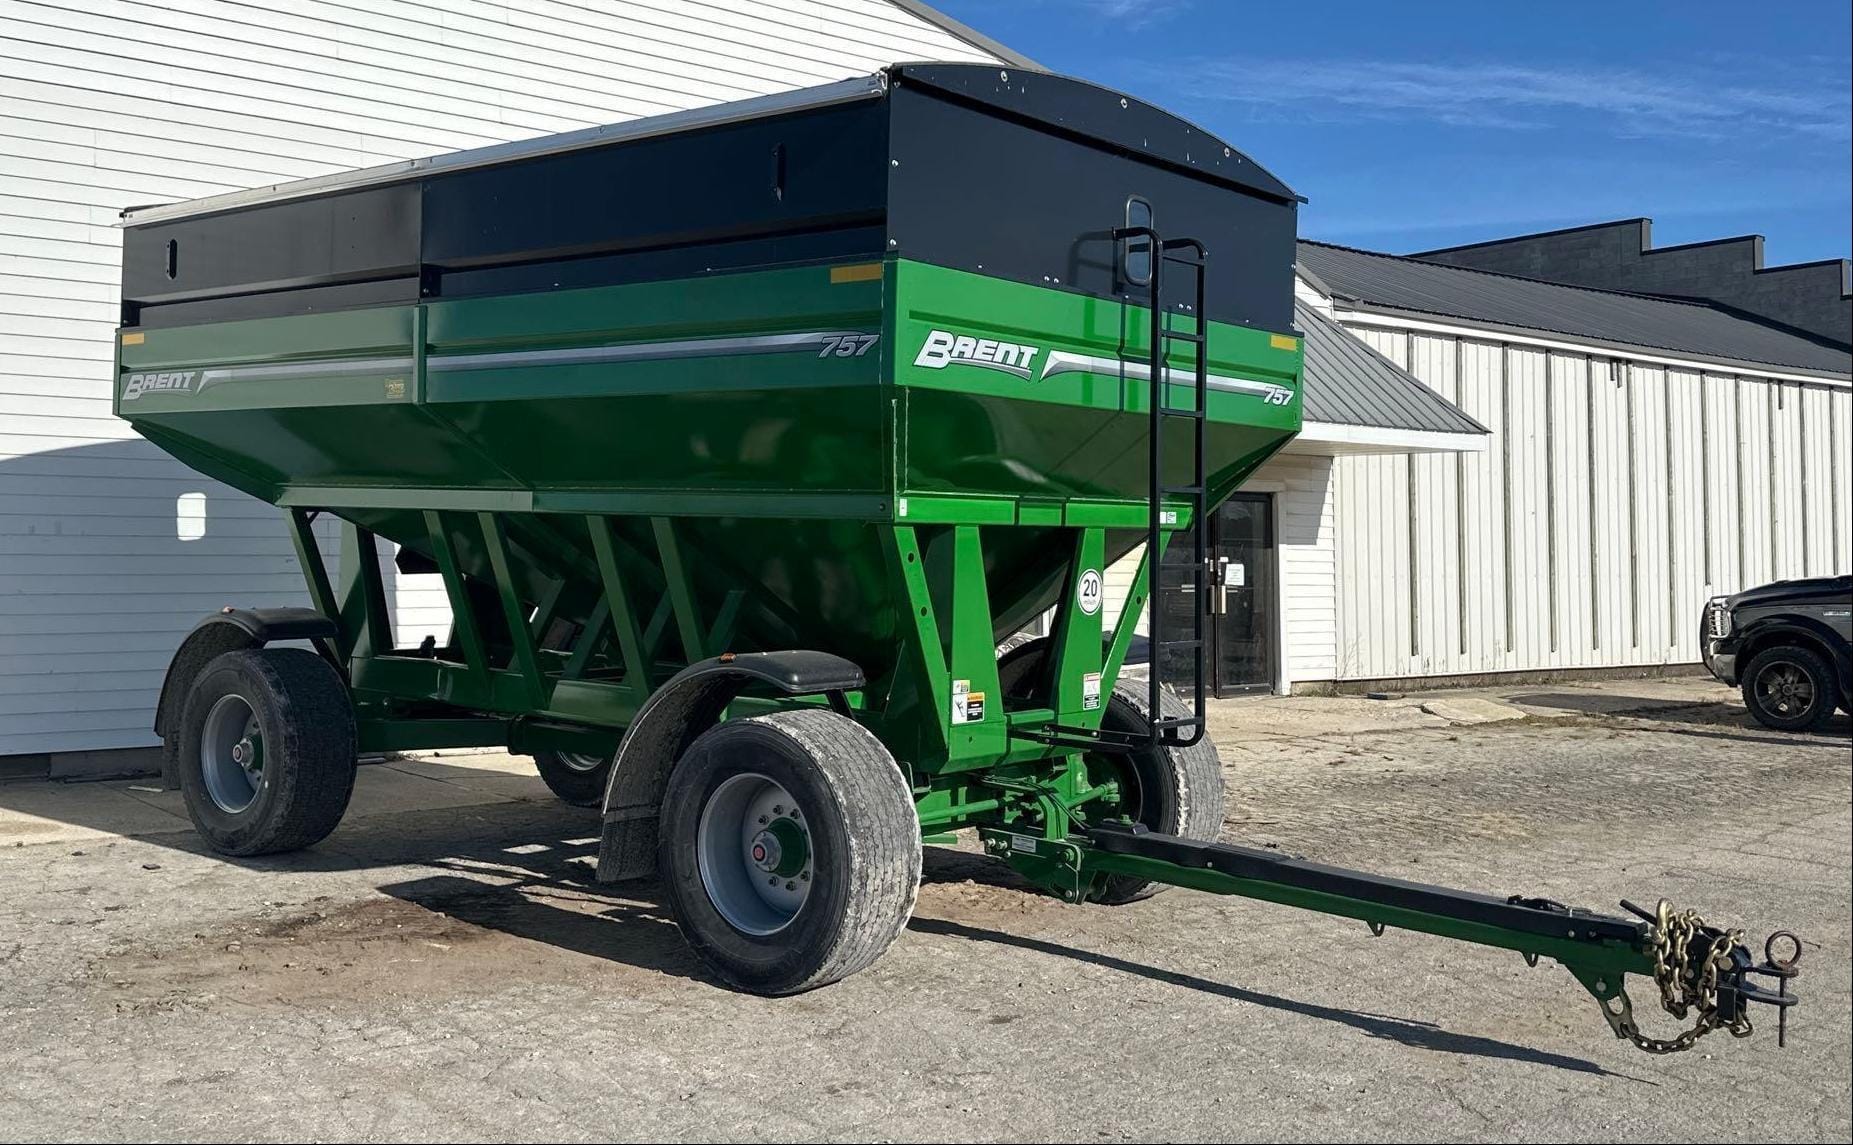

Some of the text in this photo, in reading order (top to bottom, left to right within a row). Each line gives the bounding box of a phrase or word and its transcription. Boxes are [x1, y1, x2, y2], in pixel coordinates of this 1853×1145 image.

[819, 335, 879, 358] 757
[913, 329, 1039, 372] BRENT
[122, 371, 196, 400] BRENT
[1263, 386, 1295, 405] 757
[1083, 579, 1098, 597] 20
